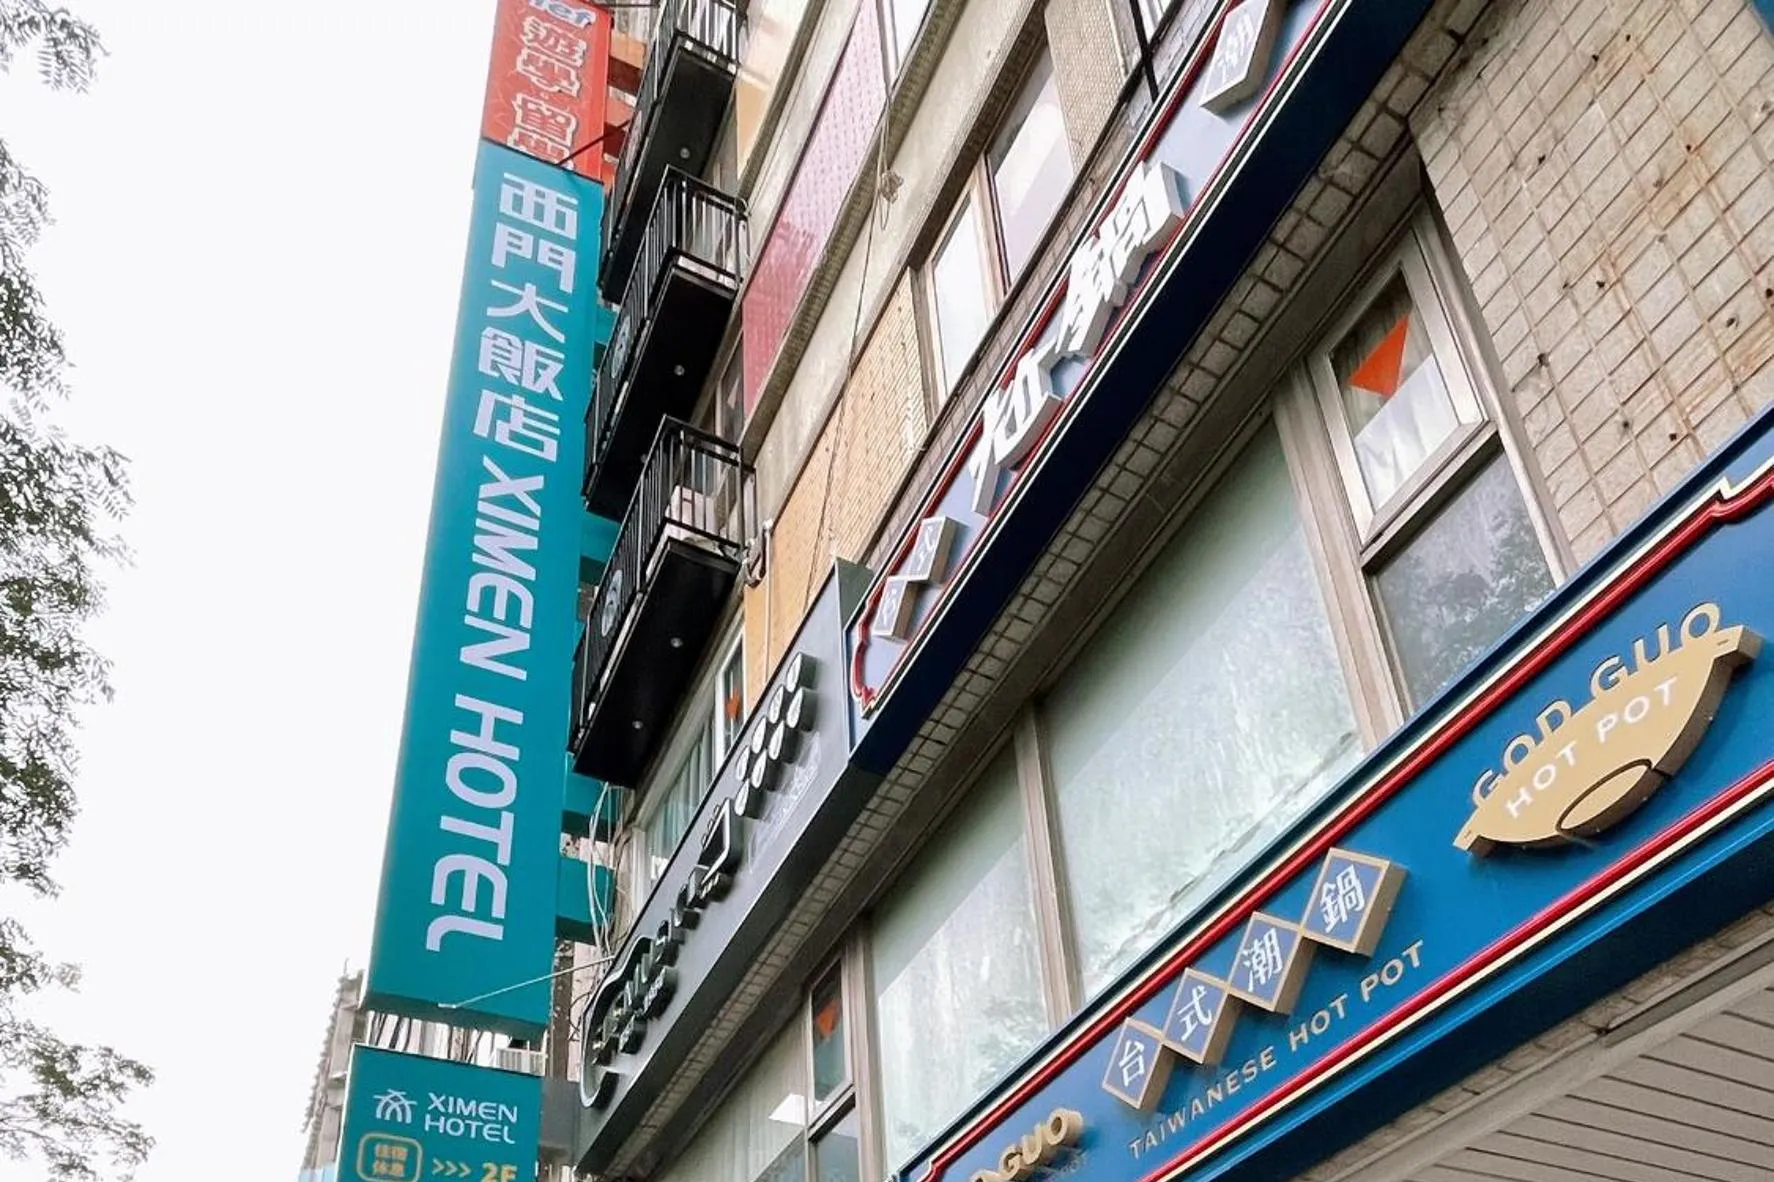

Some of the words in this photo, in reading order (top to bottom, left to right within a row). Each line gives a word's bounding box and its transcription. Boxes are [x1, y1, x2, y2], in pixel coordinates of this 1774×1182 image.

[473, 172, 578, 463] 西門大飯店
[459, 455, 545, 681] XIMEN
[1472, 699, 1573, 809] GOD
[1590, 602, 1721, 701] GUO
[1504, 740, 1578, 818] HOT
[1595, 675, 1678, 743] POT
[426, 692, 524, 953] HOTEL
[1117, 864, 1366, 1087] 台式潮鍋
[1128, 1045, 1278, 1160] TAIWANESE
[1288, 993, 1349, 1052] HOT
[1359, 939, 1424, 1003] POT
[424, 1113, 516, 1145] HOTEL
[427, 1092, 519, 1123] XIMEN
[998, 1107, 1079, 1182] GUO
